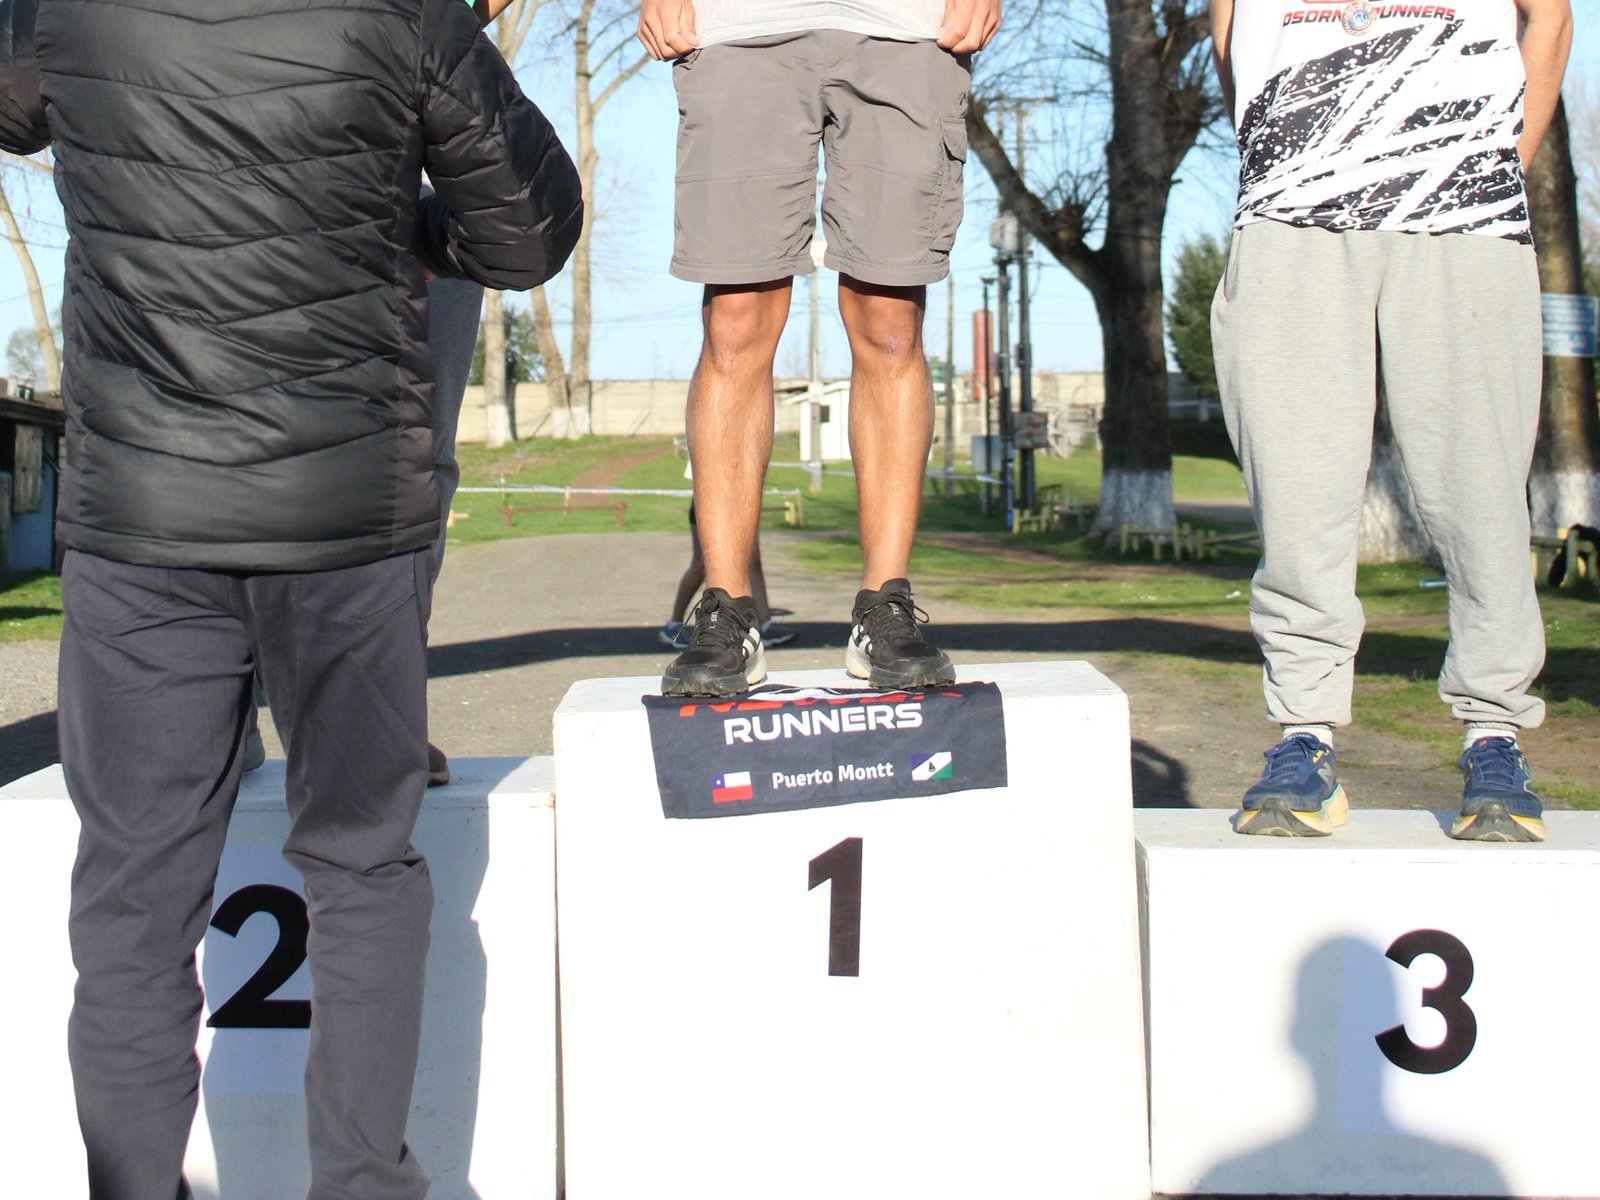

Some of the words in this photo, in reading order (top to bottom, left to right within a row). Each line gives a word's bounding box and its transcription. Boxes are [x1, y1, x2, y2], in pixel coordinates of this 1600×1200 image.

[1282, 9, 1343, 27] OSORN
[723, 703, 923, 745] RUNNERS
[772, 769, 834, 790] Puerto
[838, 762, 894, 782] Montt
[808, 836, 863, 977] 1
[206, 883, 312, 1029] 2
[1374, 928, 1477, 1075] 3
